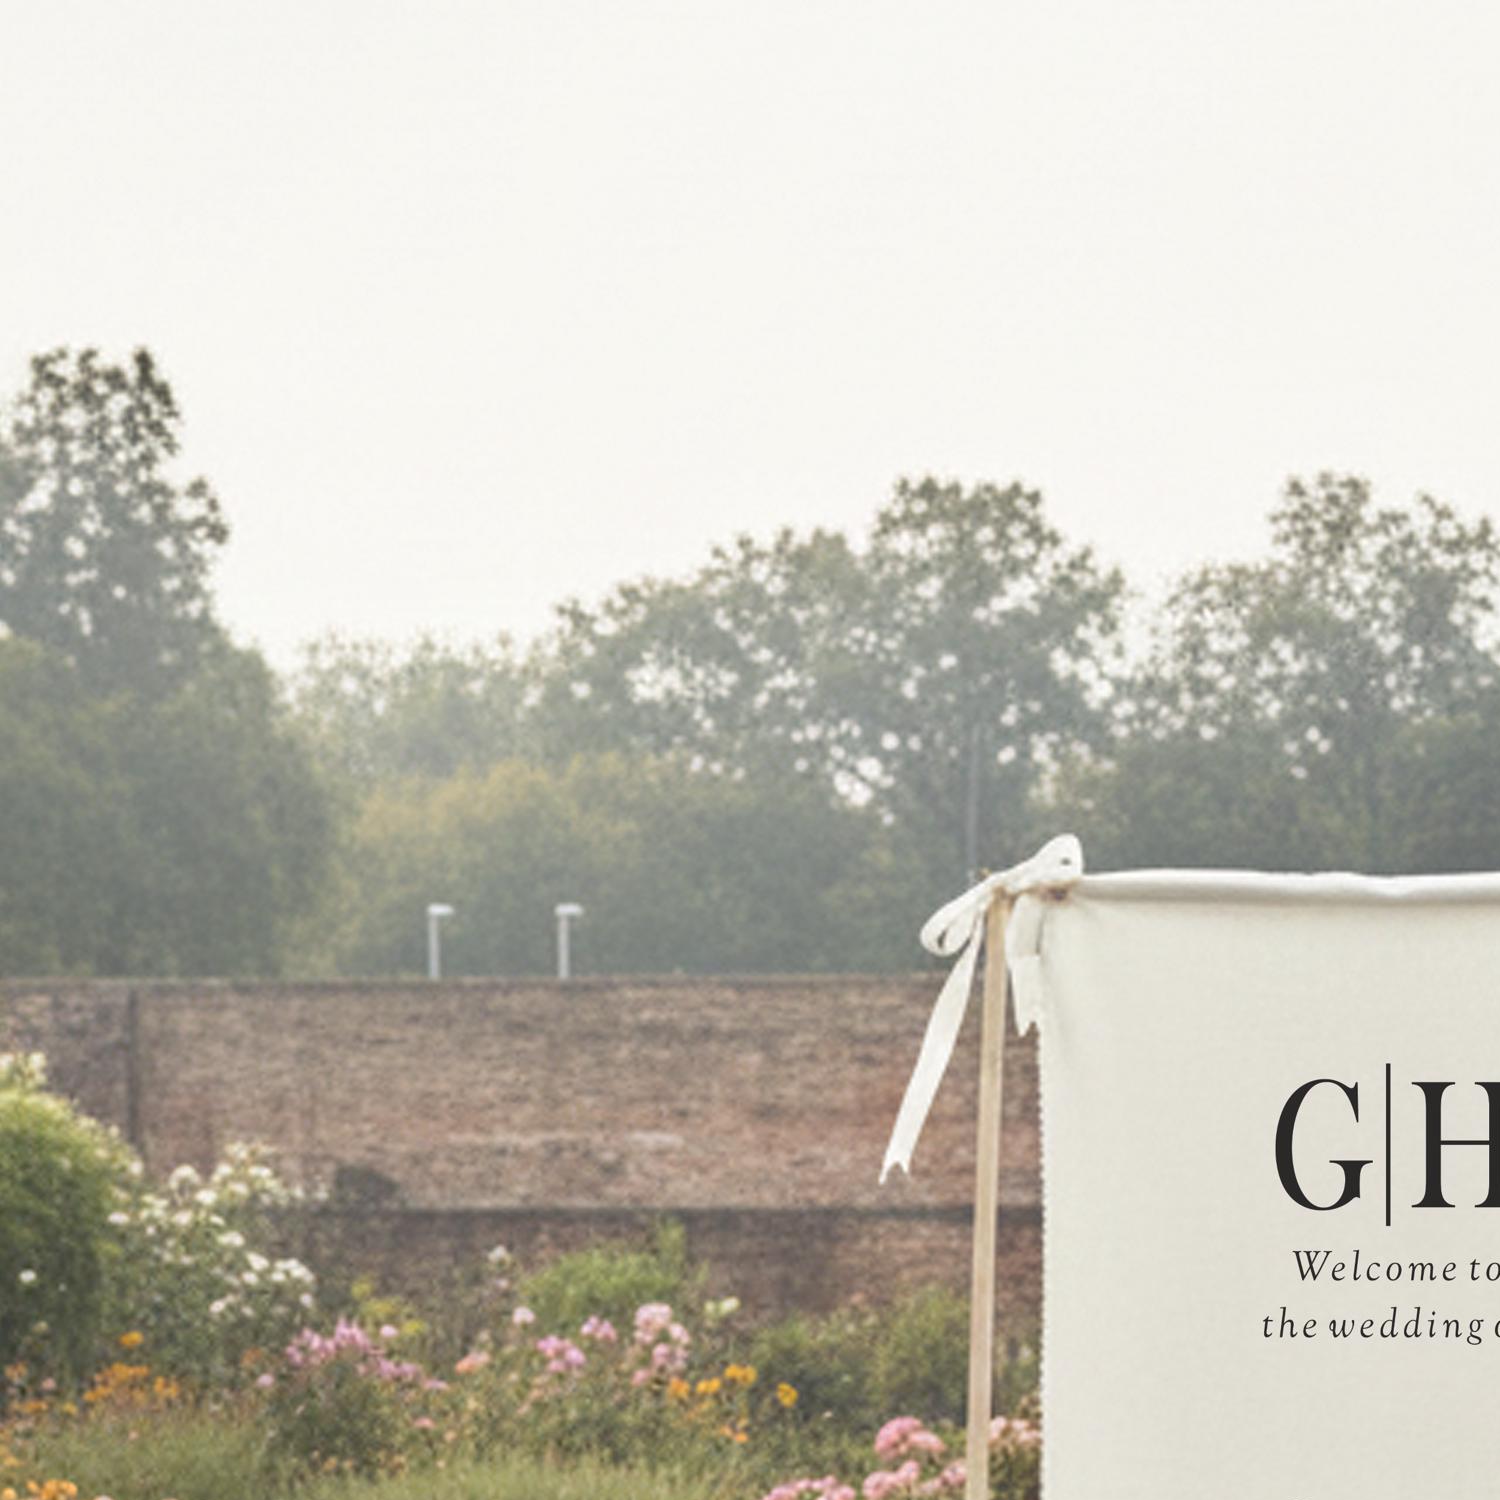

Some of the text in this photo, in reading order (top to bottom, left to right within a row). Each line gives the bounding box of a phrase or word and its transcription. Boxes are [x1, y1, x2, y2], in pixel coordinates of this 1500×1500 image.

[1292, 1250, 1500, 1281] Welcome to
[1263, 1307, 1317, 1338] the
[1329, 1307, 1484, 1345] wedding
